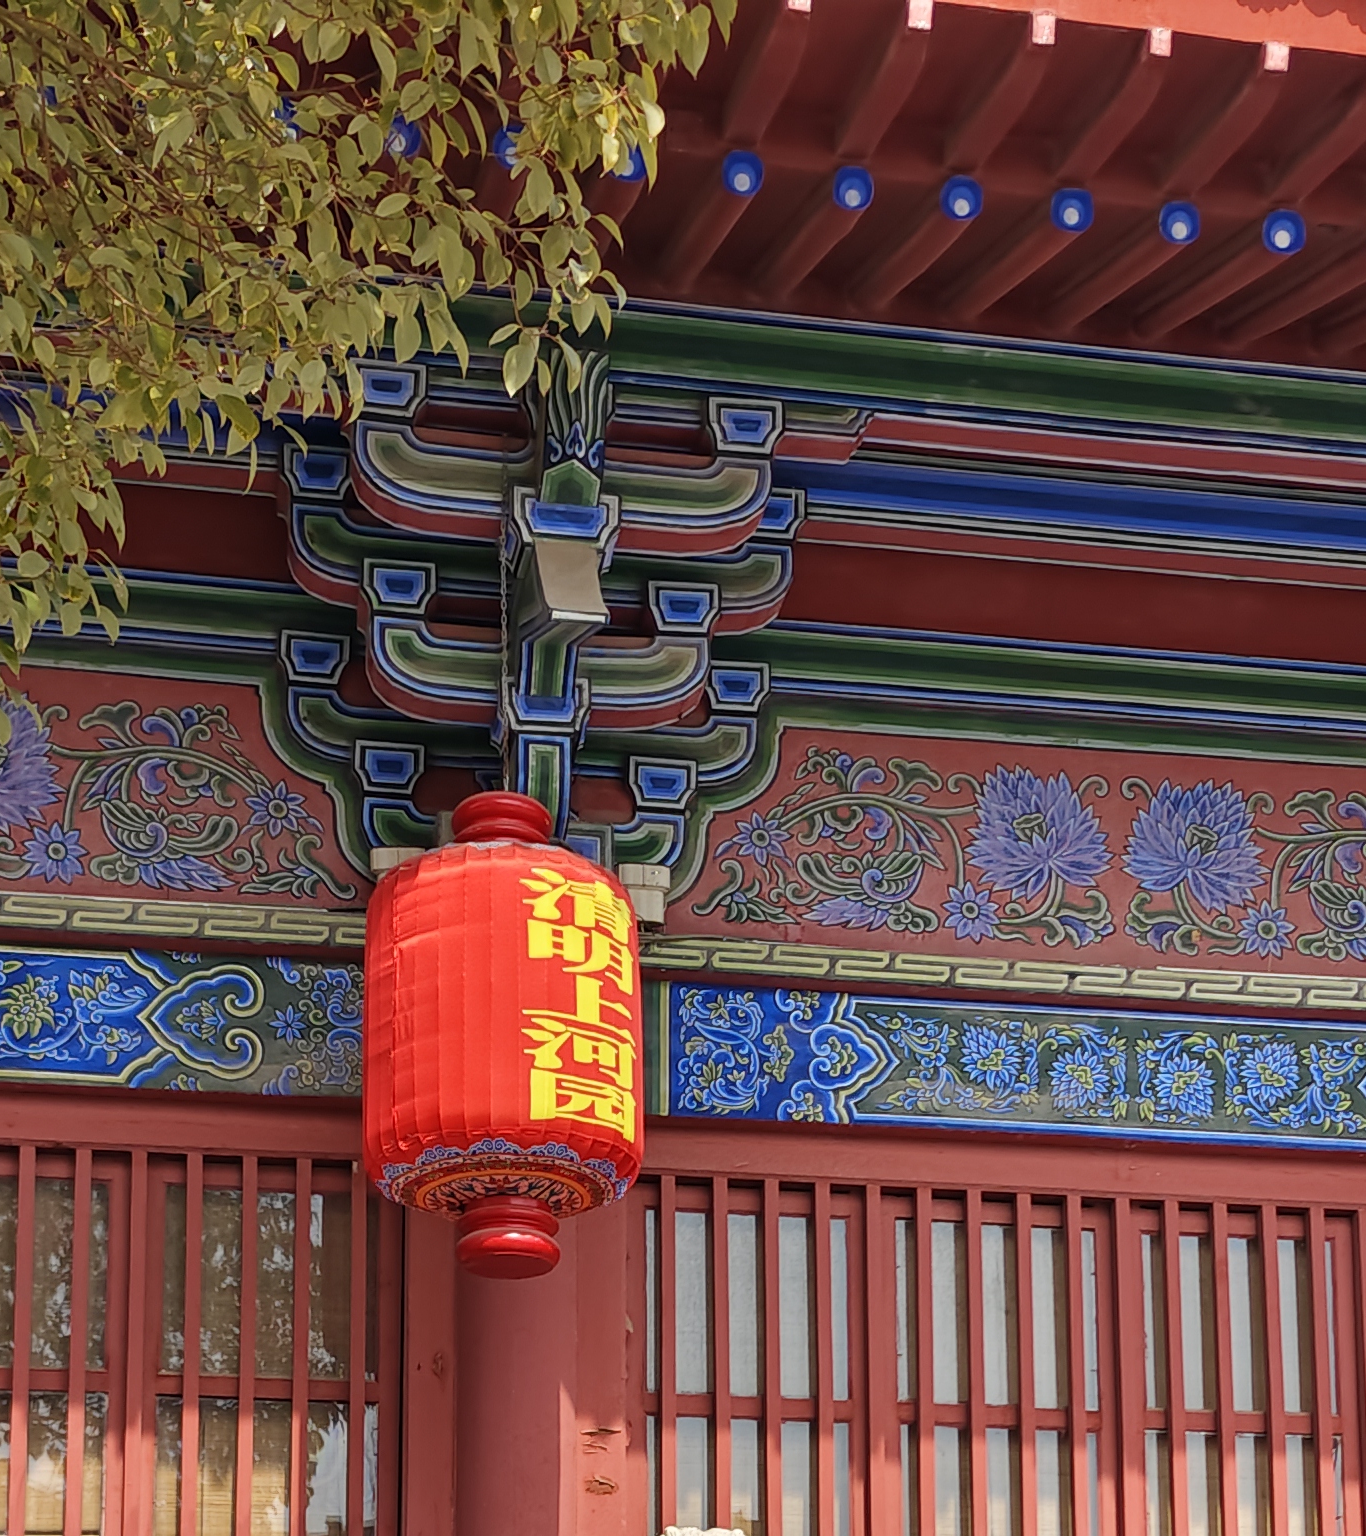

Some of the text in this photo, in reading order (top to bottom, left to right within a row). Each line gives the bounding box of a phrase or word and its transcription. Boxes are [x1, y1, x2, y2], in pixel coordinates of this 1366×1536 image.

[520, 868, 637, 1144] 清明上河园
